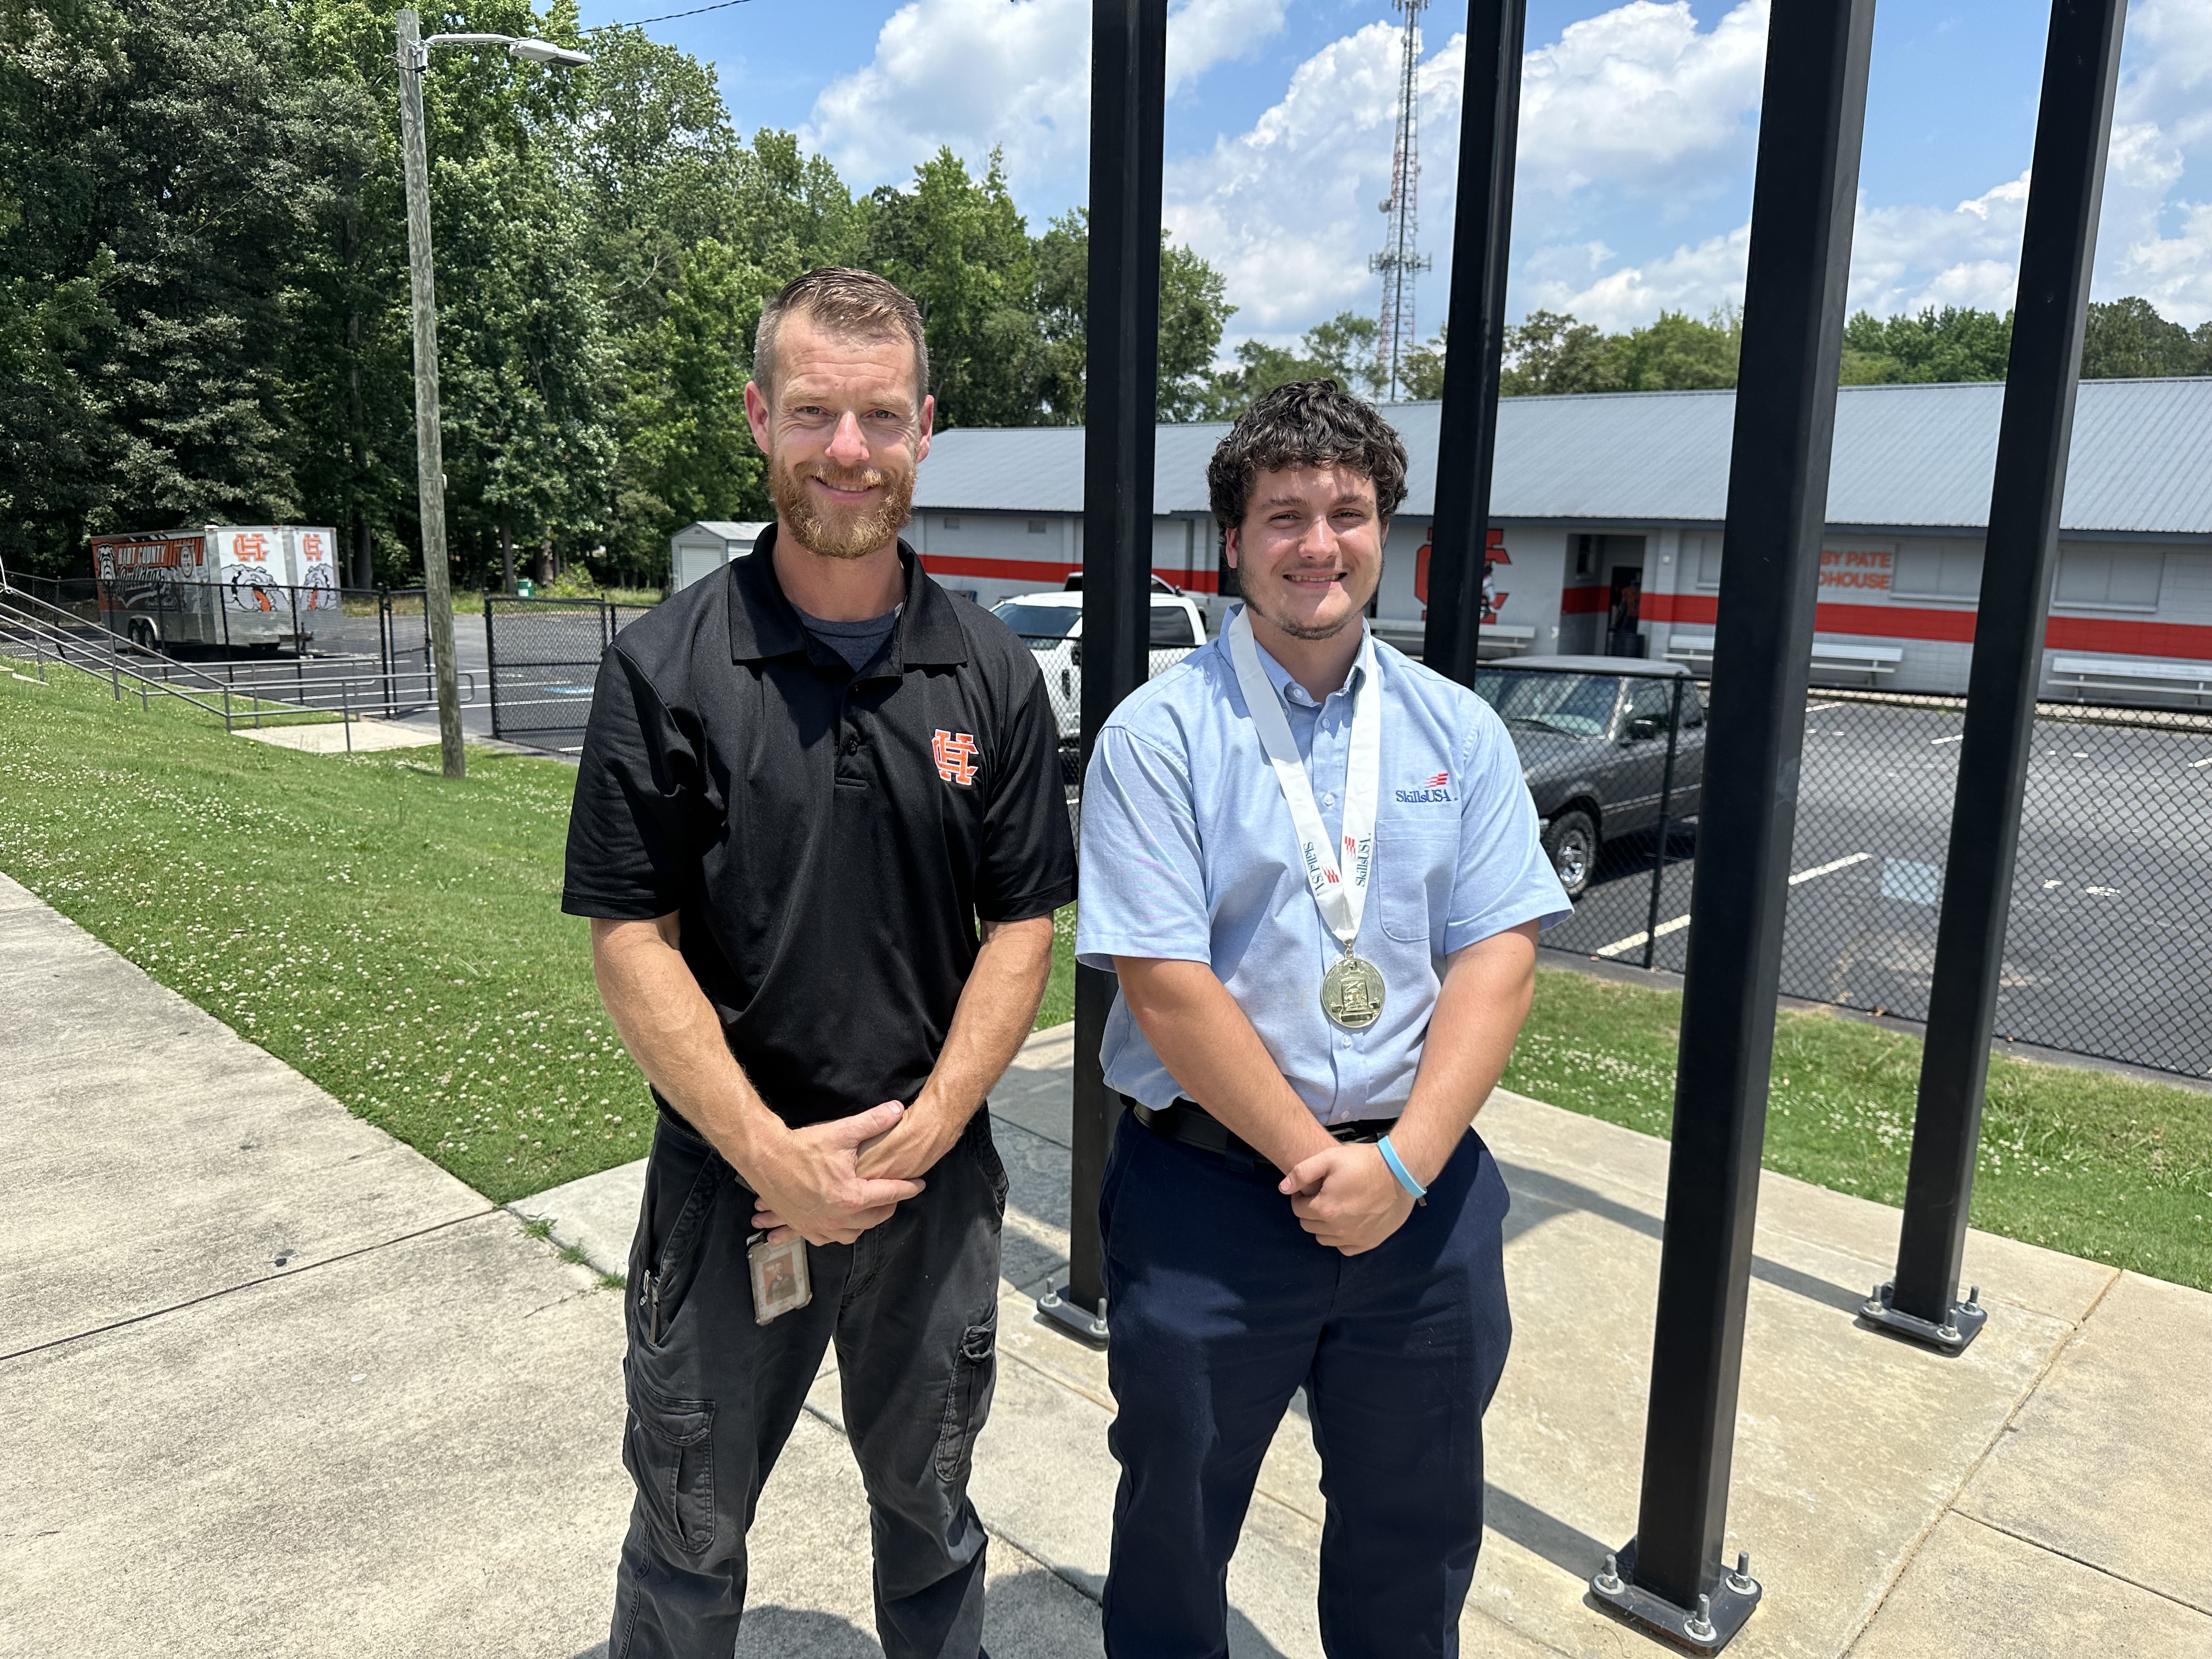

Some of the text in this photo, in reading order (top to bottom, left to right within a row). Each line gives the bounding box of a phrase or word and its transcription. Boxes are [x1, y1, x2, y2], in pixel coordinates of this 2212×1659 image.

[117, 545, 166, 565] HART COUNTY
[1846, 550, 1892, 568] PATE
[1395, 789, 1452, 803] SkillsUSA
